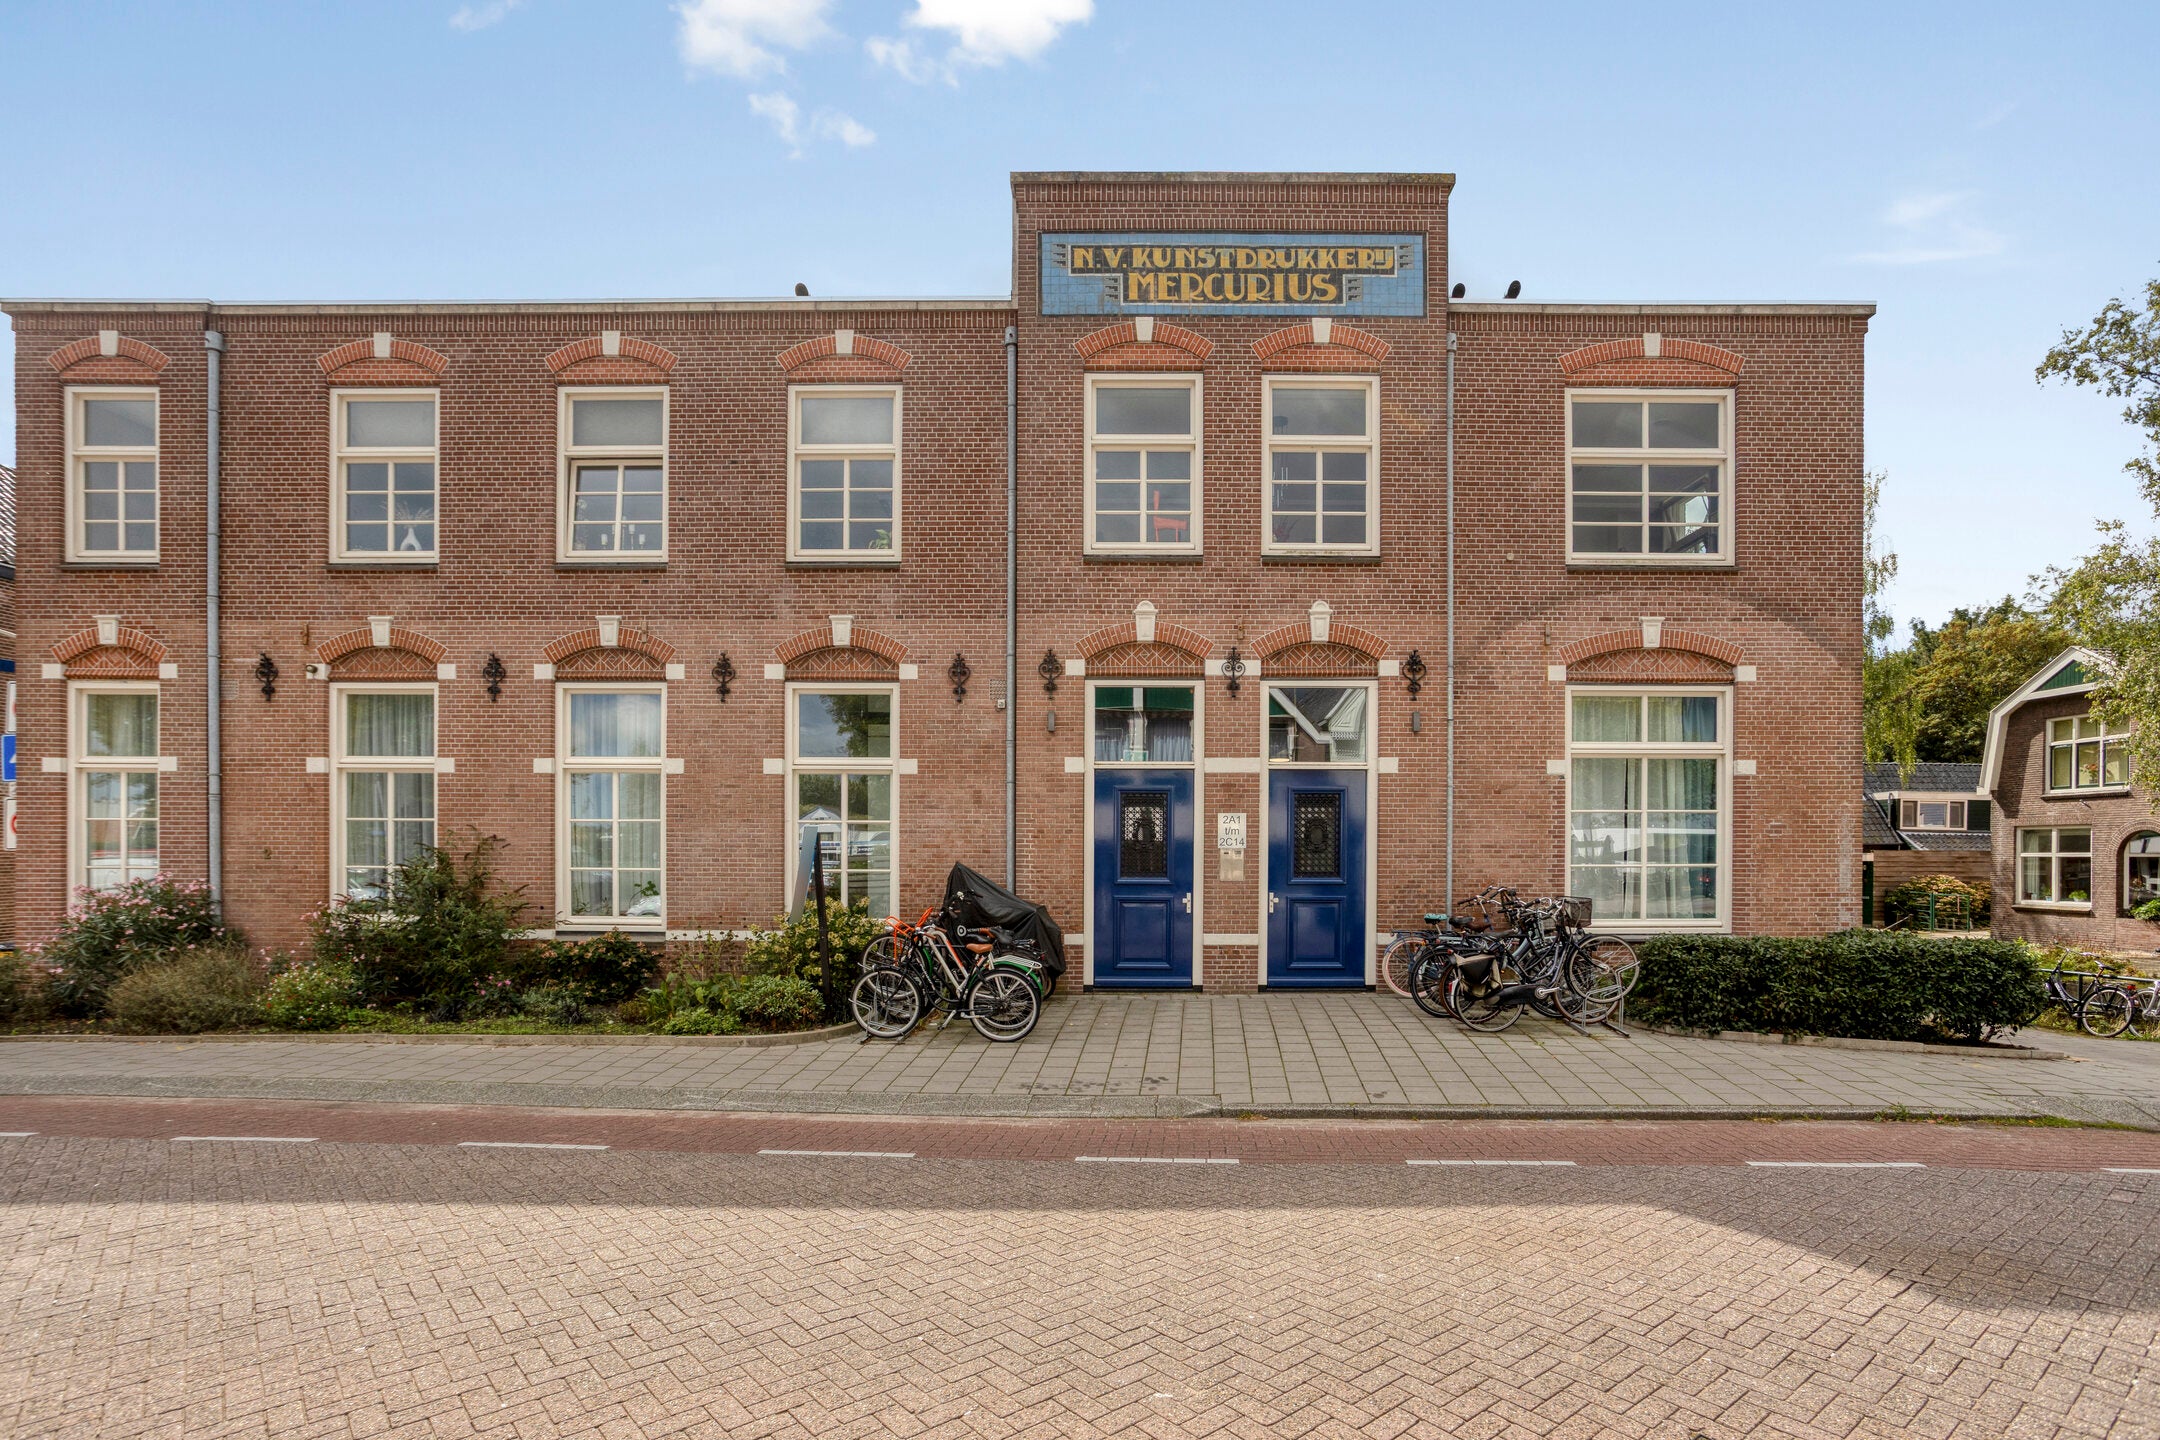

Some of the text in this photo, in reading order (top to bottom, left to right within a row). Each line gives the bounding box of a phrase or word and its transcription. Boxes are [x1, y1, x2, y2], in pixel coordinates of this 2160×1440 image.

[1127, 272, 1338, 302] MERCURIUS
[1222, 815, 1241, 824] 2A1
[1225, 827, 1240, 835] t/m
[1219, 837, 1245, 846] 2C14
